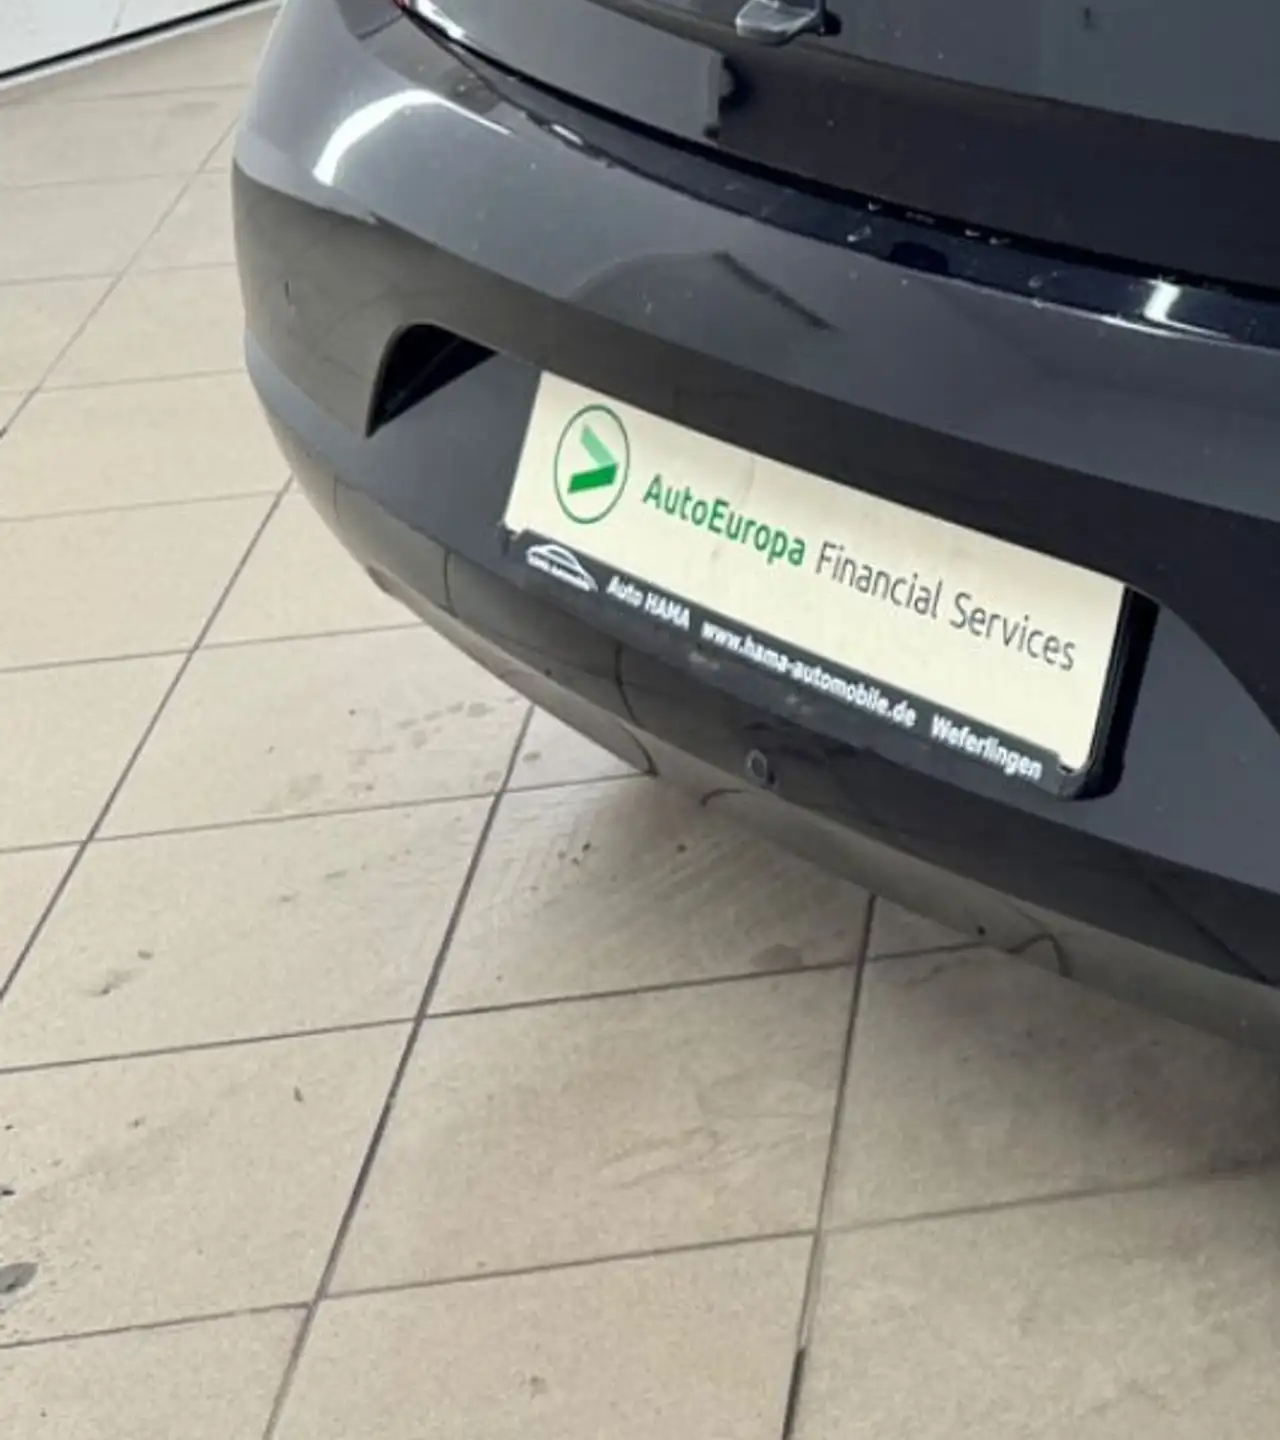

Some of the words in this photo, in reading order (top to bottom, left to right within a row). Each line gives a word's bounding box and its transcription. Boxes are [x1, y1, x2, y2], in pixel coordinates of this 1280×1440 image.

[642, 474, 807, 566] AutoEuropa
[816, 541, 941, 620] Financial
[950, 592, 1076, 672] Services
[606, 574, 645, 607] Auto
[644, 591, 691, 632] HAMA
[702, 620, 917, 729] www.hama-automobile.de
[931, 712, 1043, 781] Weferlingen
